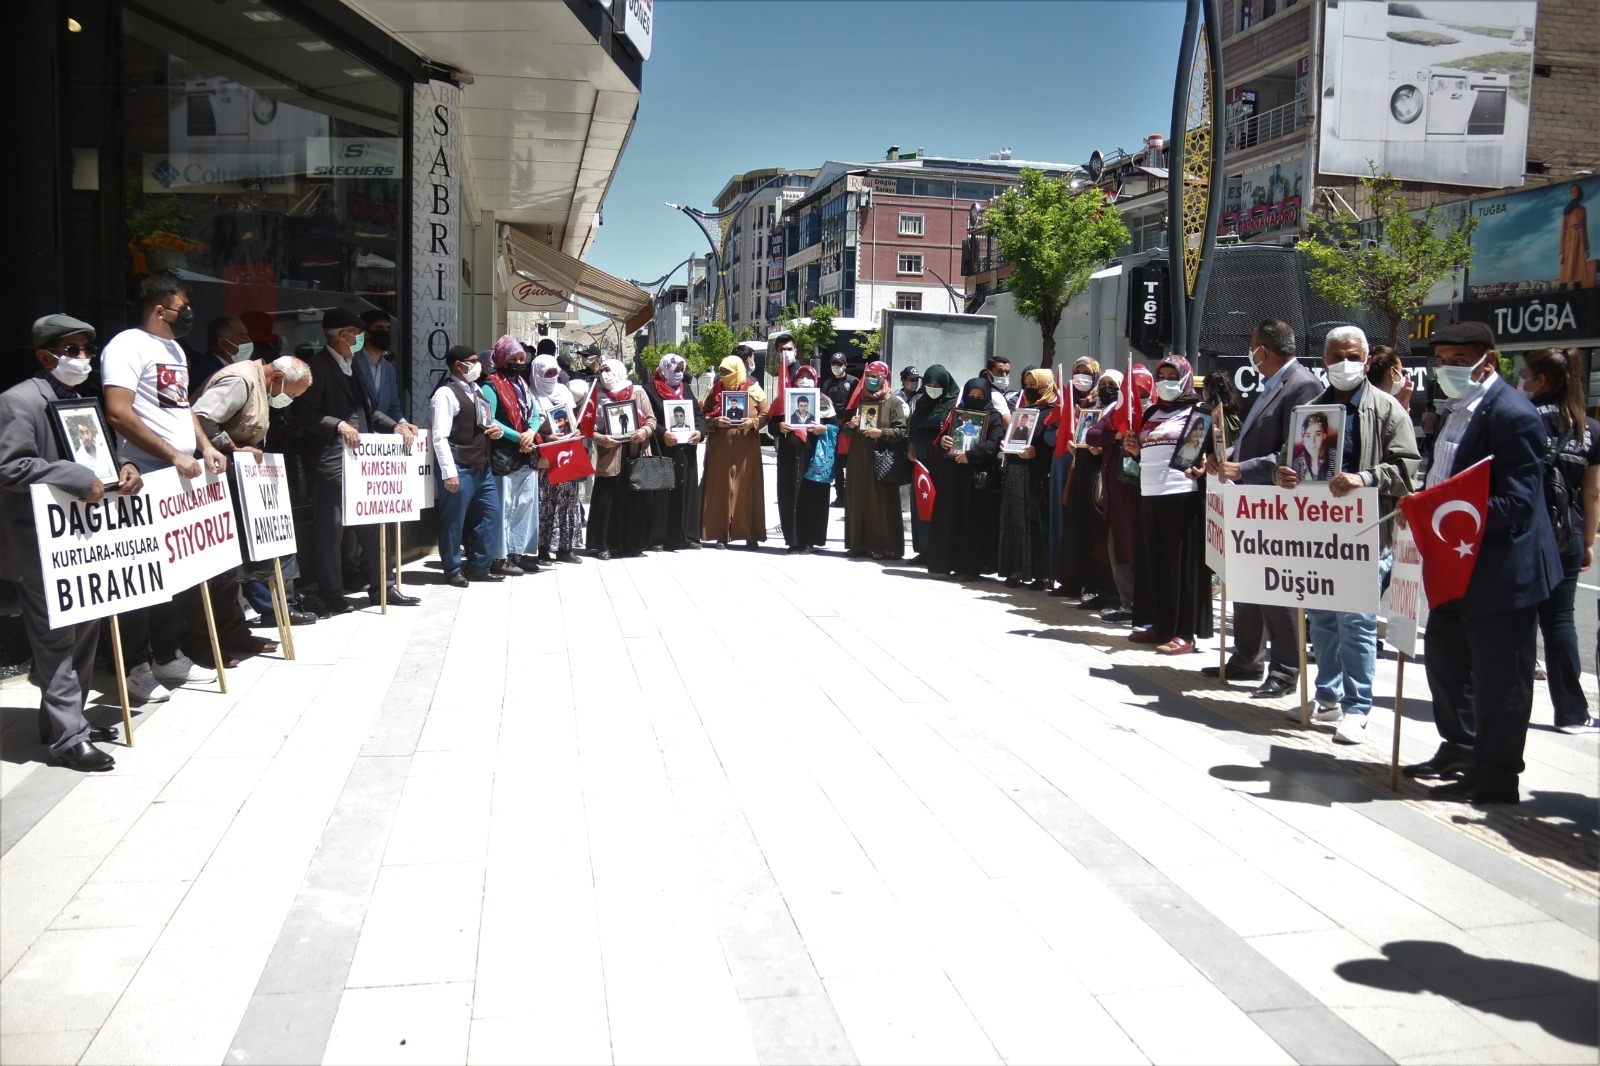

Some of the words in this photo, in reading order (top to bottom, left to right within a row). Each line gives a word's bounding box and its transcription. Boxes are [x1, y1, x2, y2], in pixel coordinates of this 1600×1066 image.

[183, 162, 287, 186] Columbia
[313, 165, 396, 177] SKECHERS
[1143, 281, 1159, 325] T-65
[1494, 299, 1577, 335] TUĞBA
[159, 480, 227, 520] OCUKLARIMIZI
[258, 483, 280, 511] VAN
[355, 498, 413, 517] OLMAYACAK
[1235, 494, 1289, 521] Artık
[1293, 495, 1364, 524] Yeter!
[51, 536, 160, 569] KURTLARA-KUŞLARA
[1230, 529, 1370, 562] Yakamızdan
[56, 560, 164, 612] BIRAKIN
[1264, 566, 1335, 601] Düşün
